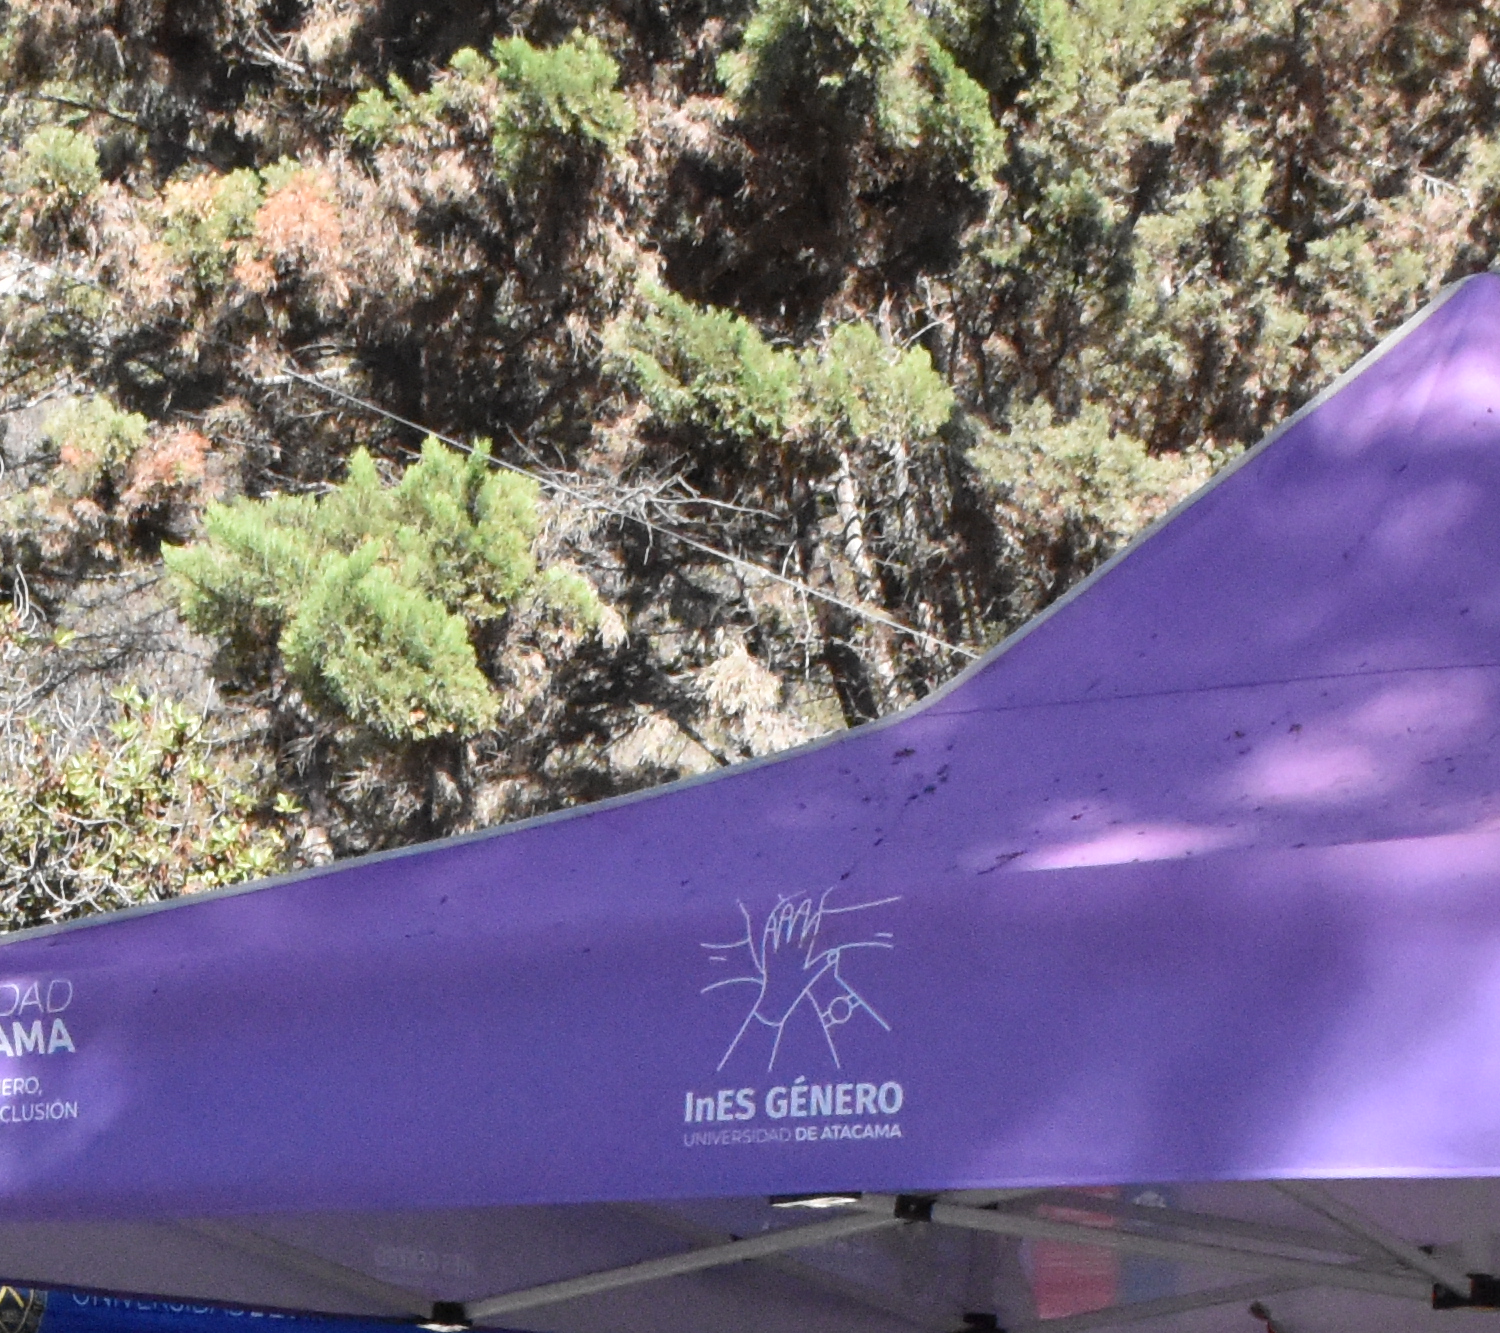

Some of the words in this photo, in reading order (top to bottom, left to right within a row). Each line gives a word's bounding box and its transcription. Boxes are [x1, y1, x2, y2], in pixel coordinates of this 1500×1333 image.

[684, 1088, 757, 1122] InES
[765, 1075, 904, 1119] GÉNERO
[684, 1127, 792, 1147] UNIVERSIDAD
[795, 1126, 818, 1141] DE
[820, 1124, 903, 1140] ATACAMA
